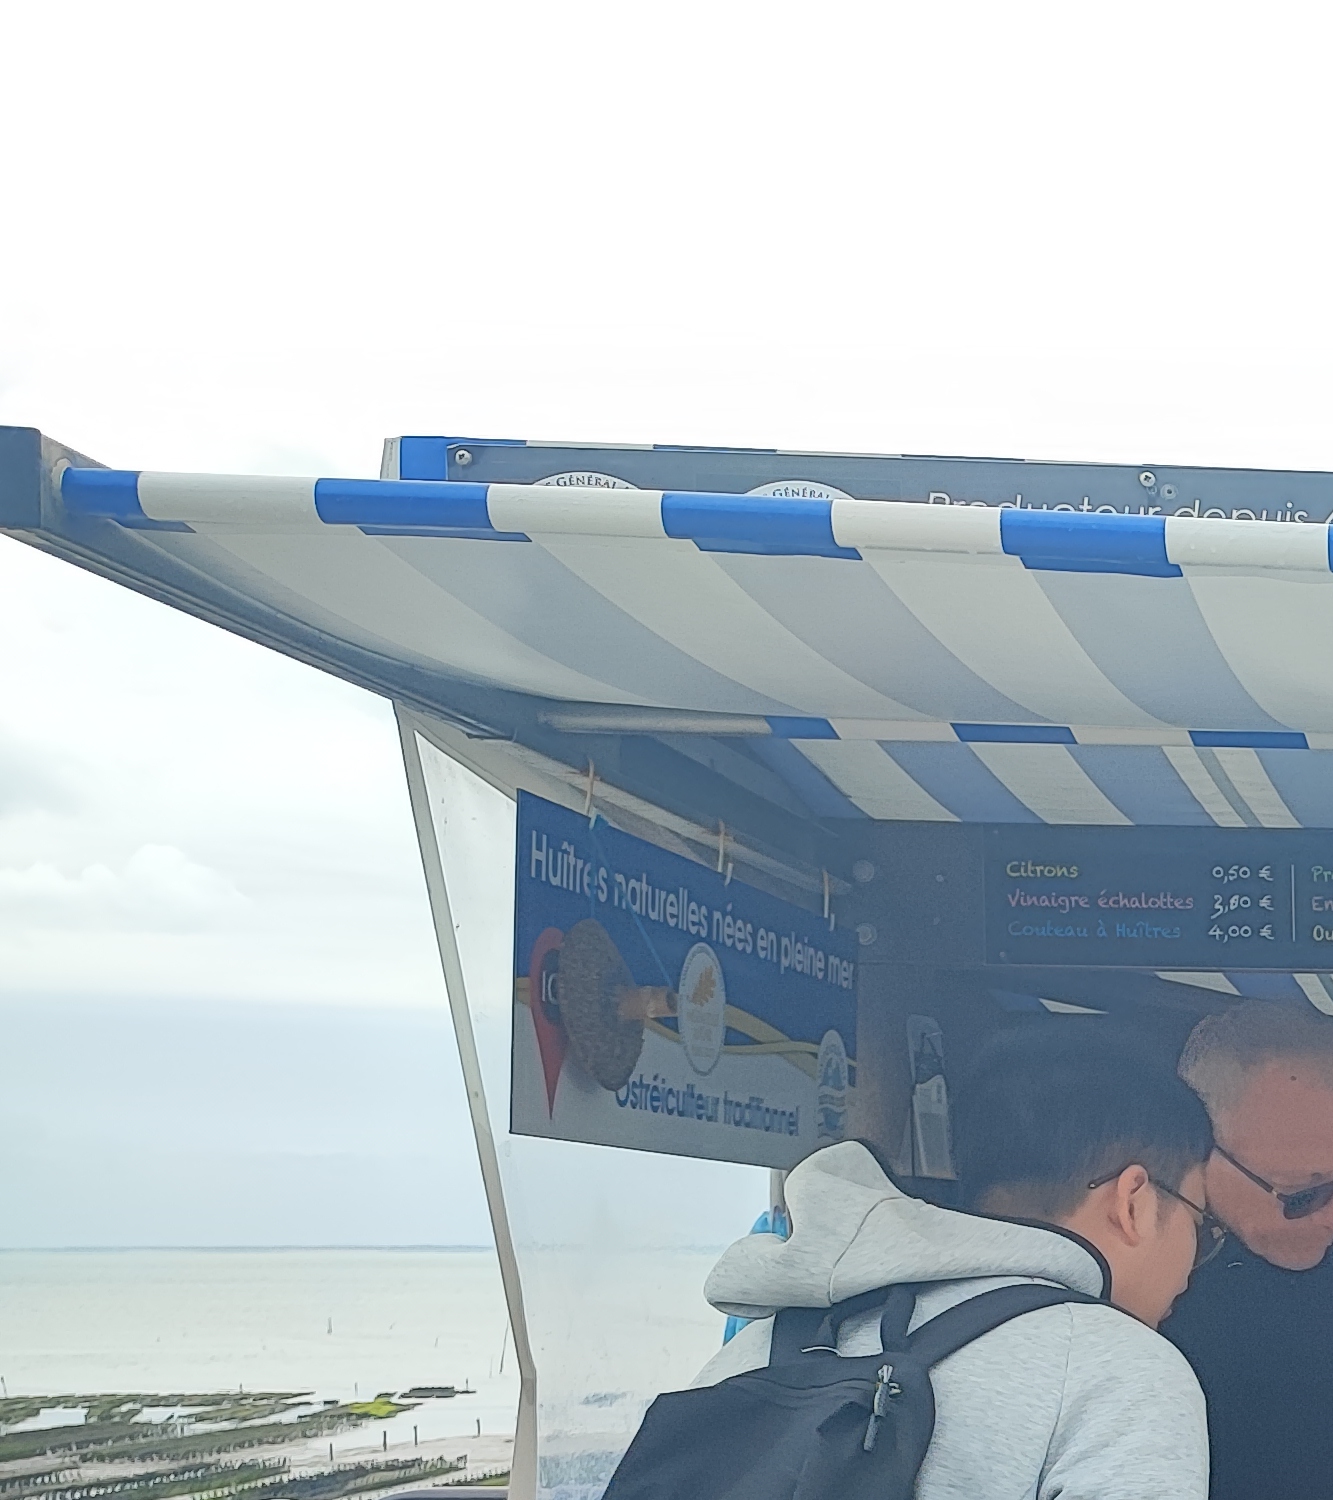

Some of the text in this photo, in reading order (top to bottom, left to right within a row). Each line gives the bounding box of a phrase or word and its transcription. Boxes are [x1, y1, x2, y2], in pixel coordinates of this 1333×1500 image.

[531, 830, 855, 990] Huîtres naturelles nées en pleine mer
[1006, 862, 1079, 878] Citrons
[1212, 866, 1250, 884] 0,50
